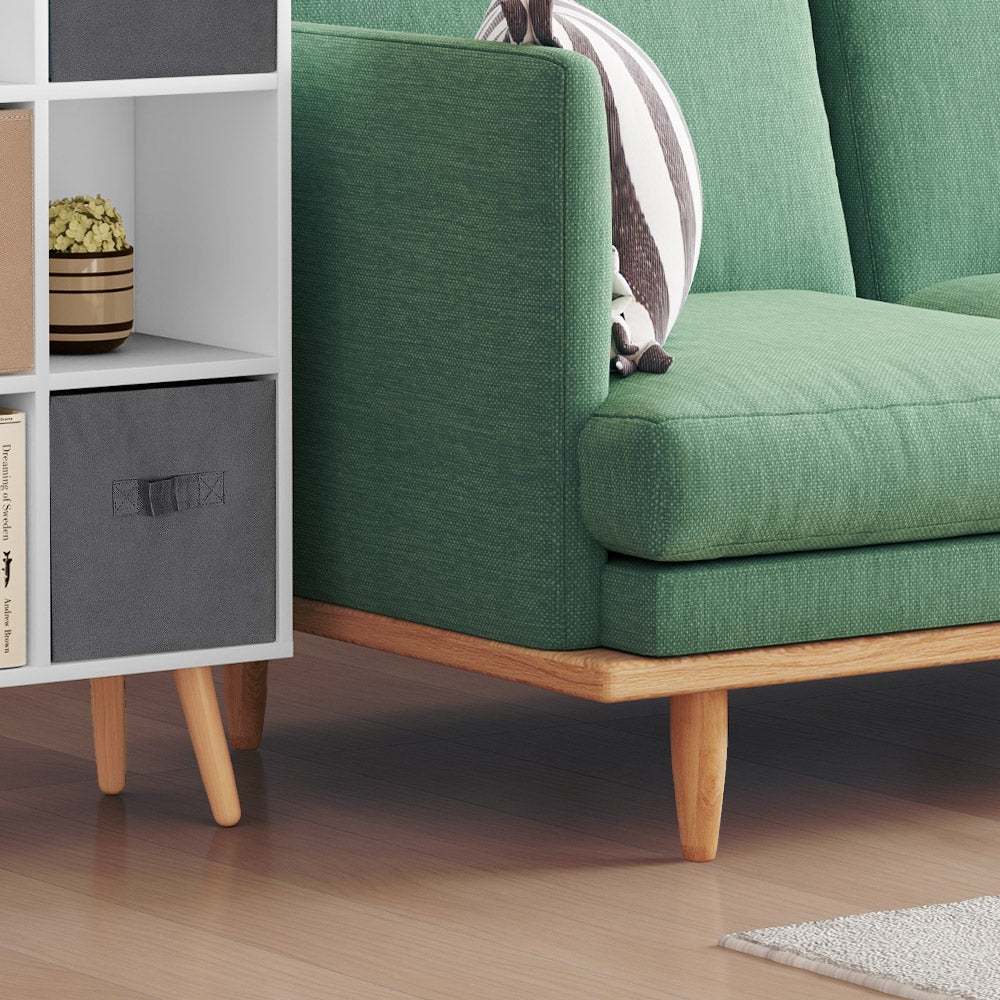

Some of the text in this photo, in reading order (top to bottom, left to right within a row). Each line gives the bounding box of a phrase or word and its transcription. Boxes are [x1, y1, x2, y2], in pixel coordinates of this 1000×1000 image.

[0, 444, 12, 542] Dreaming of Sweden
[4, 598, 12, 654] Andrew Brown
